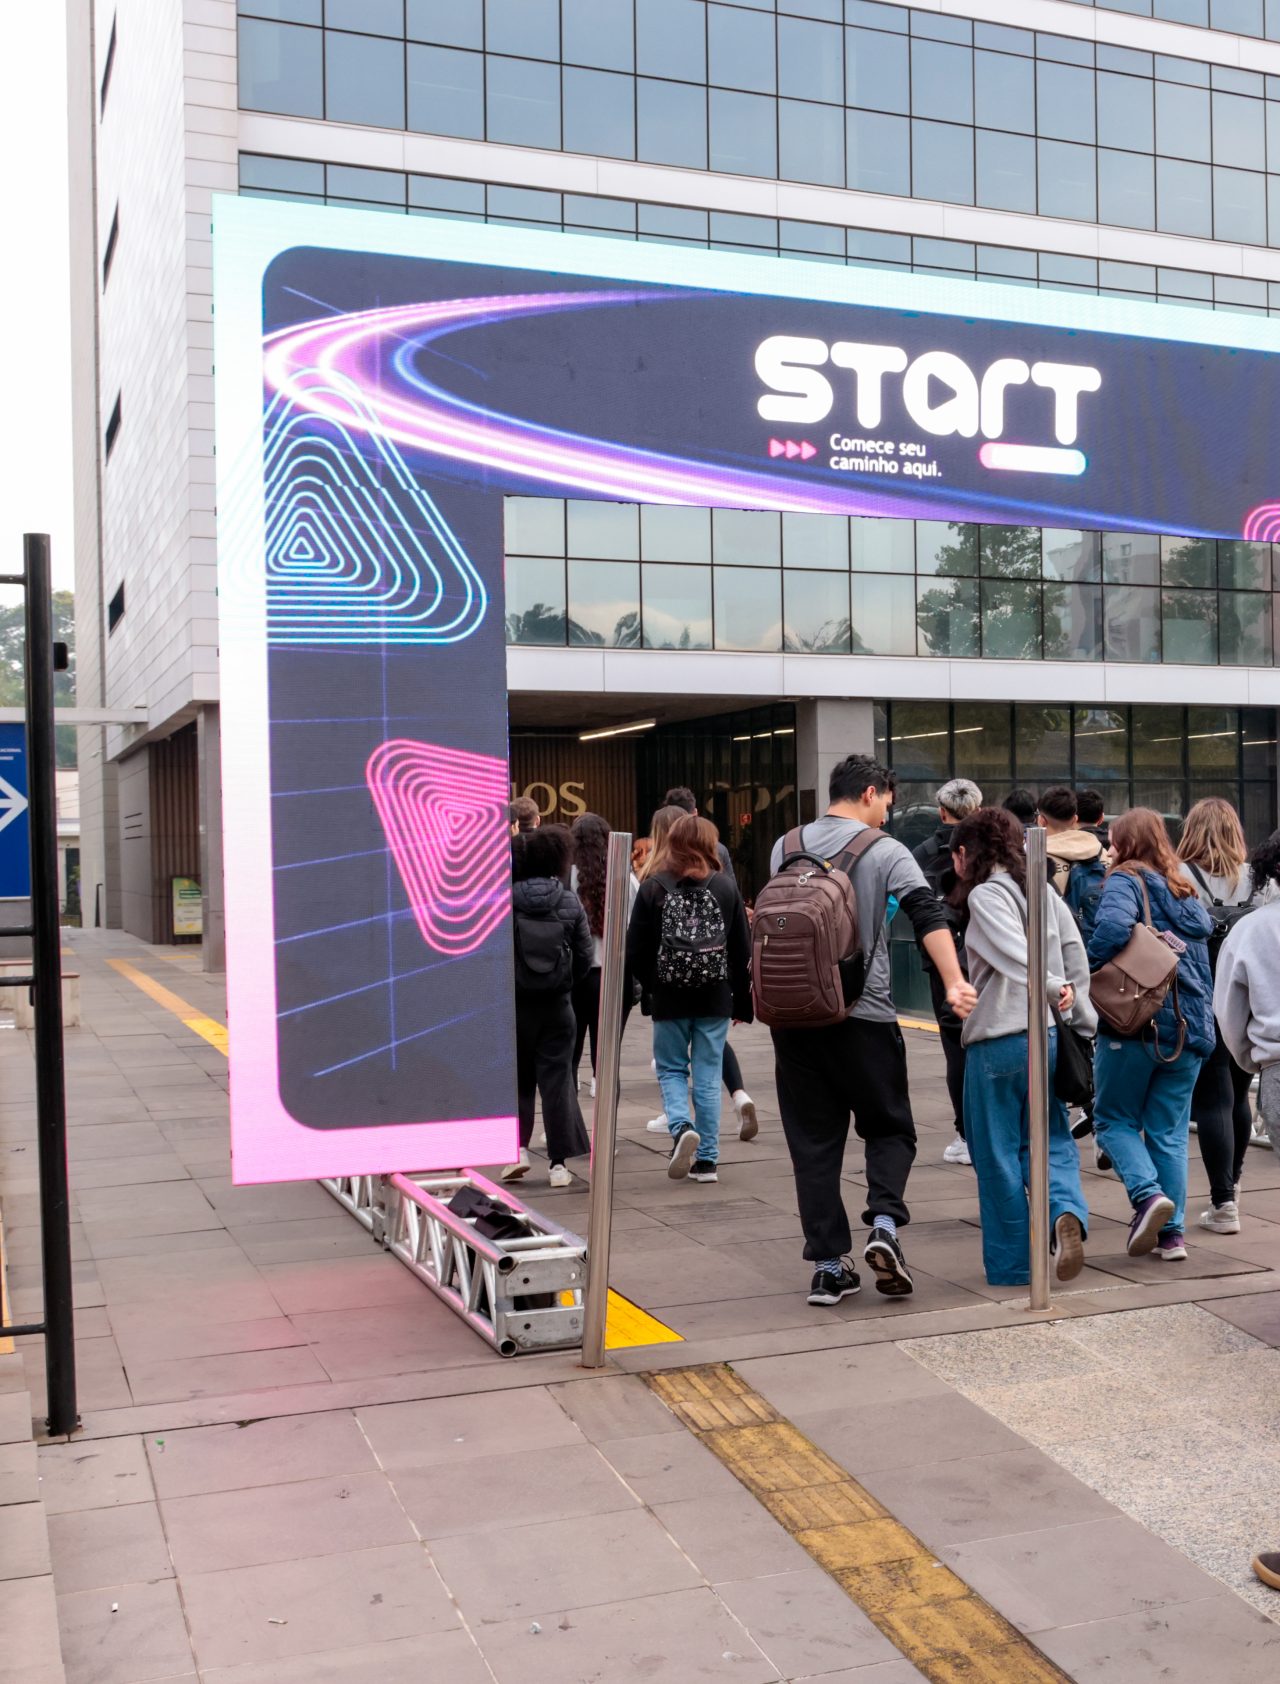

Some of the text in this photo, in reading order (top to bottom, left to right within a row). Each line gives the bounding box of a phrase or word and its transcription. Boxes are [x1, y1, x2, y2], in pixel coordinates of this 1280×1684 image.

[829, 433, 927, 457] Comece seu
[829, 455, 943, 480] caminho aqui.
